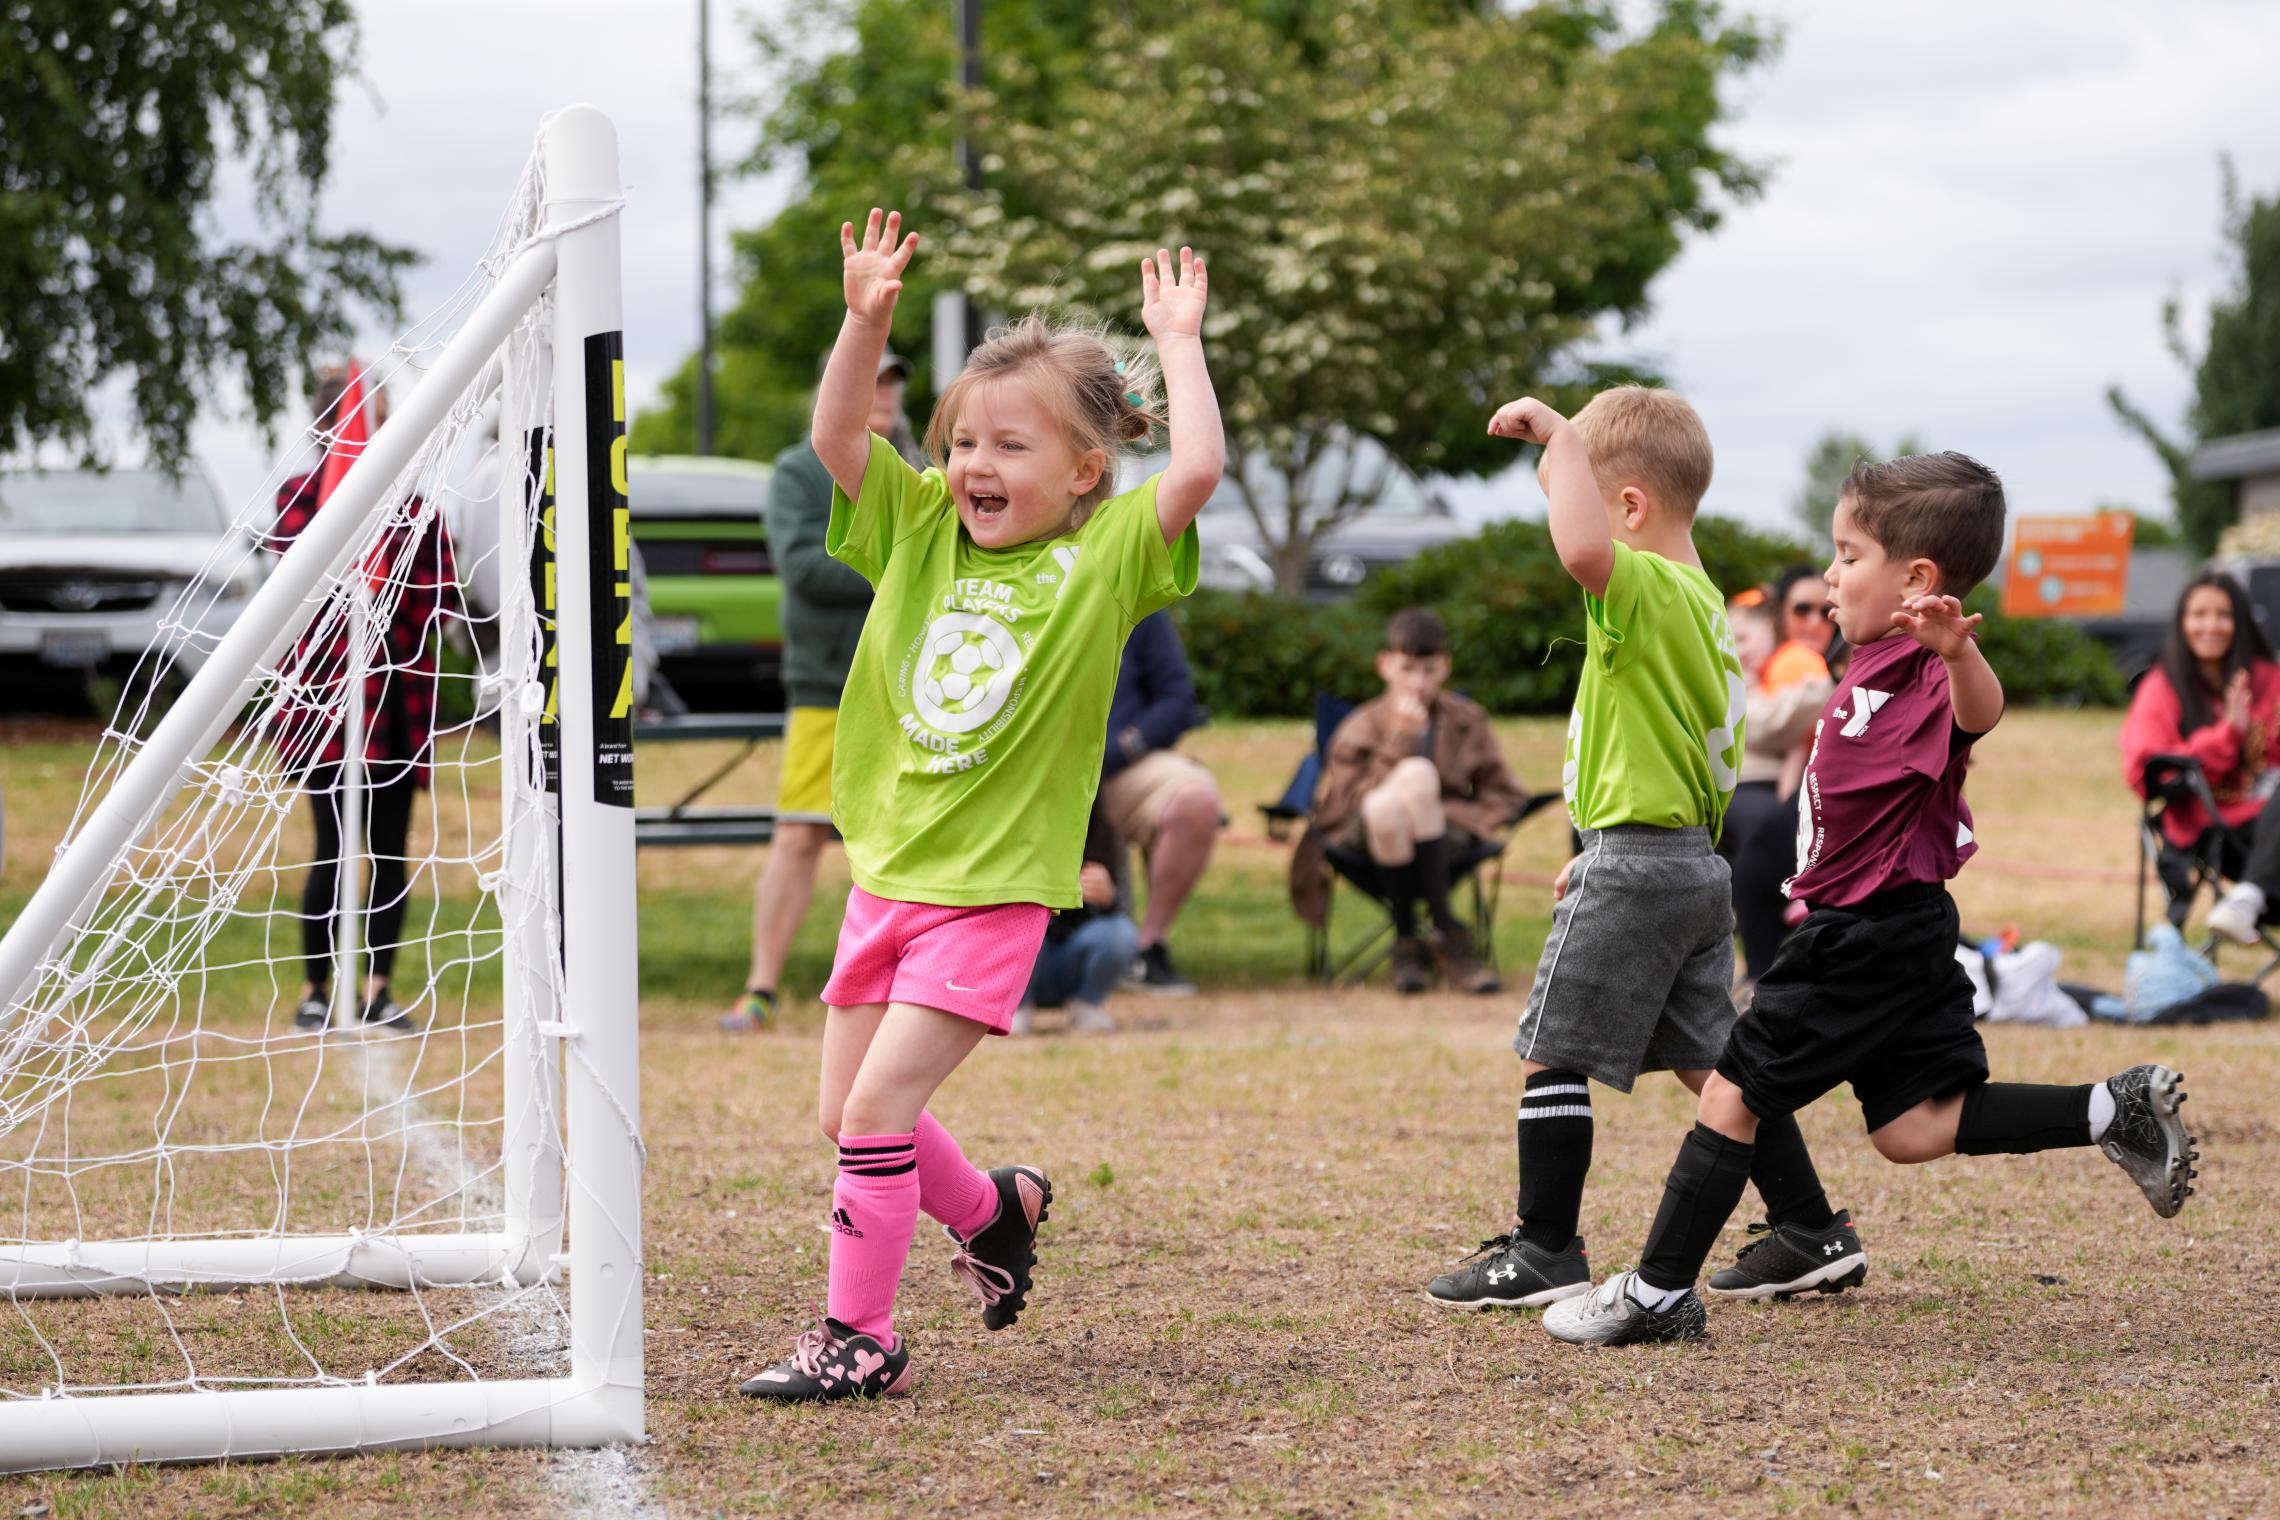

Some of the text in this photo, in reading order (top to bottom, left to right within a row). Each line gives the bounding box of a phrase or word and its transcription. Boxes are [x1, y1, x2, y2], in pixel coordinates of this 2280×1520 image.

[955, 577, 1014, 604] TEAM
[1036, 572, 1057, 585] the
[943, 594, 1024, 624] PLAYERS
[1832, 706, 1848, 720] the
[898, 712, 961, 757] MADE
[598, 753, 620, 764] NET
[925, 748, 989, 775] HERE
[1809, 772, 1823, 811] RESPECT
